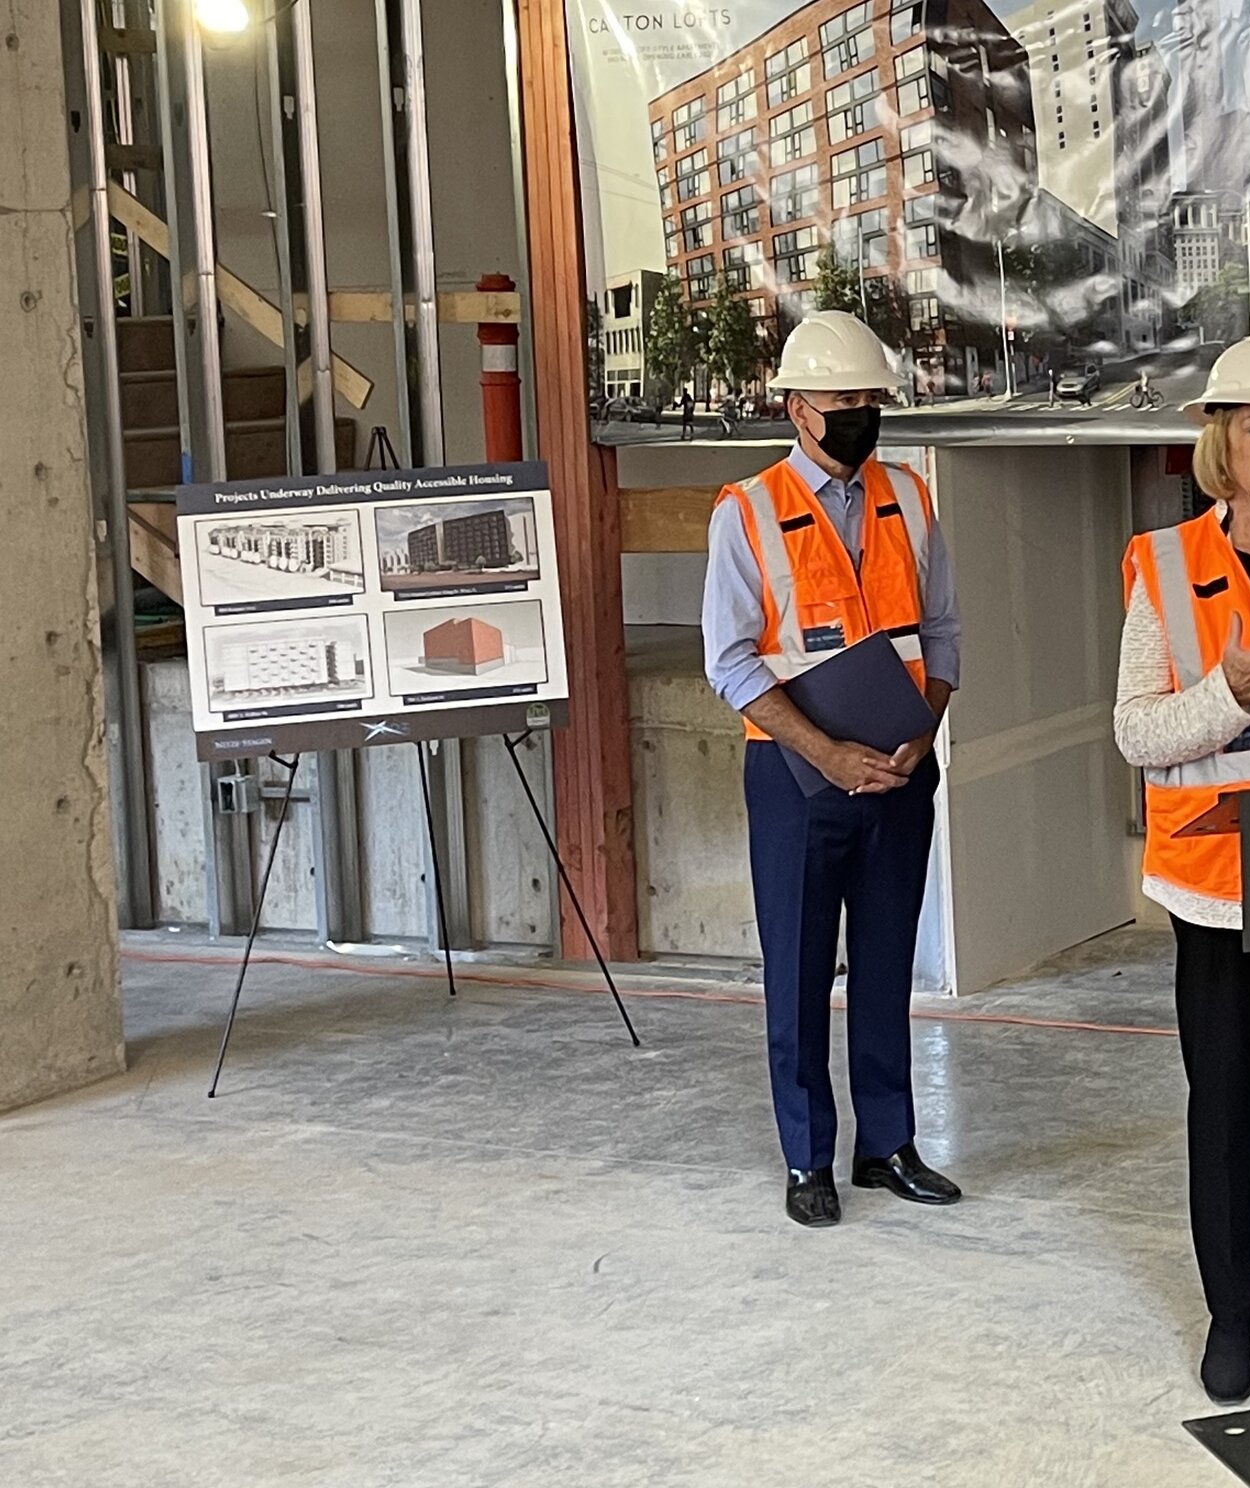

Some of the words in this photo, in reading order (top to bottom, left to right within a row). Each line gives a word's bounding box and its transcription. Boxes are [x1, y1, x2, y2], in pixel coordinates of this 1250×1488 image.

[588, 13, 664, 34] CATON
[214, 491, 258, 504] Projects
[259, 488, 314, 500] Underway
[315, 483, 372, 496] Delivering
[373, 480, 412, 493] Quality
[414, 475, 467, 489] Accessible
[468, 473, 513, 486] Housing
